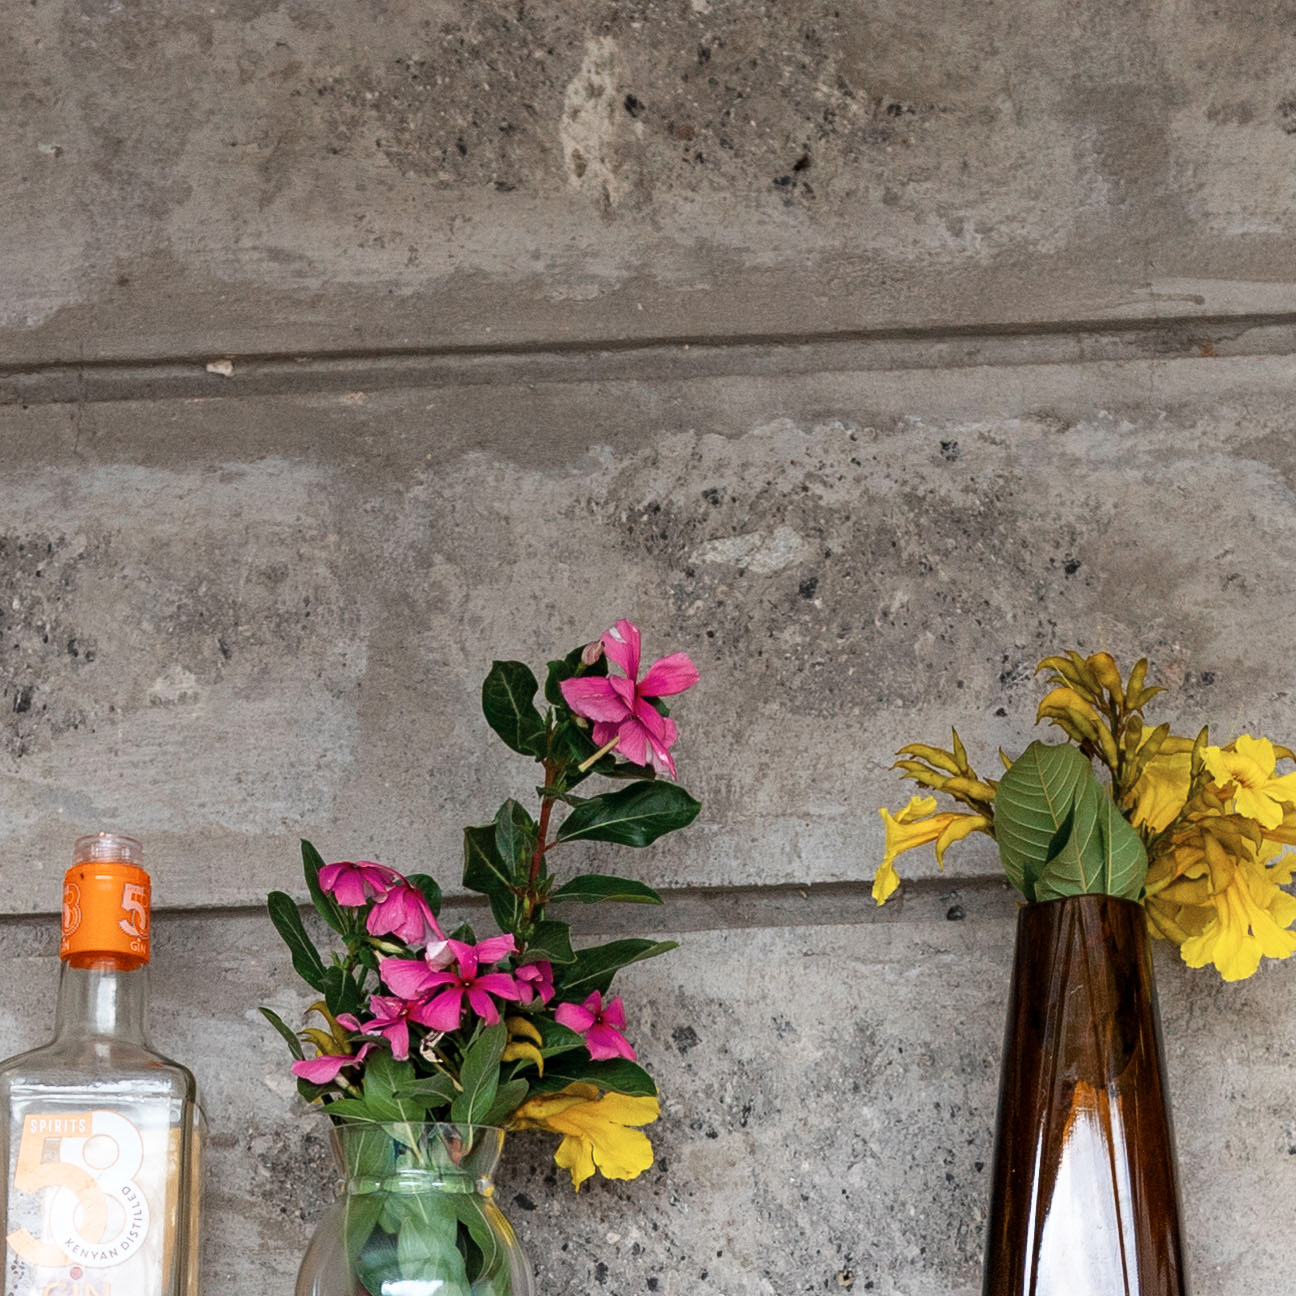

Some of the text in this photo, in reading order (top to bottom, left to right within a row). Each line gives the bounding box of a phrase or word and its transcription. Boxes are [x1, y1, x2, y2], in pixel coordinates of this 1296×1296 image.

[29, 1118, 87, 1133] SPIRITS
[6, 1109, 150, 1268] 58
[63, 1185, 143, 1261] KENYAN DISTILLED
